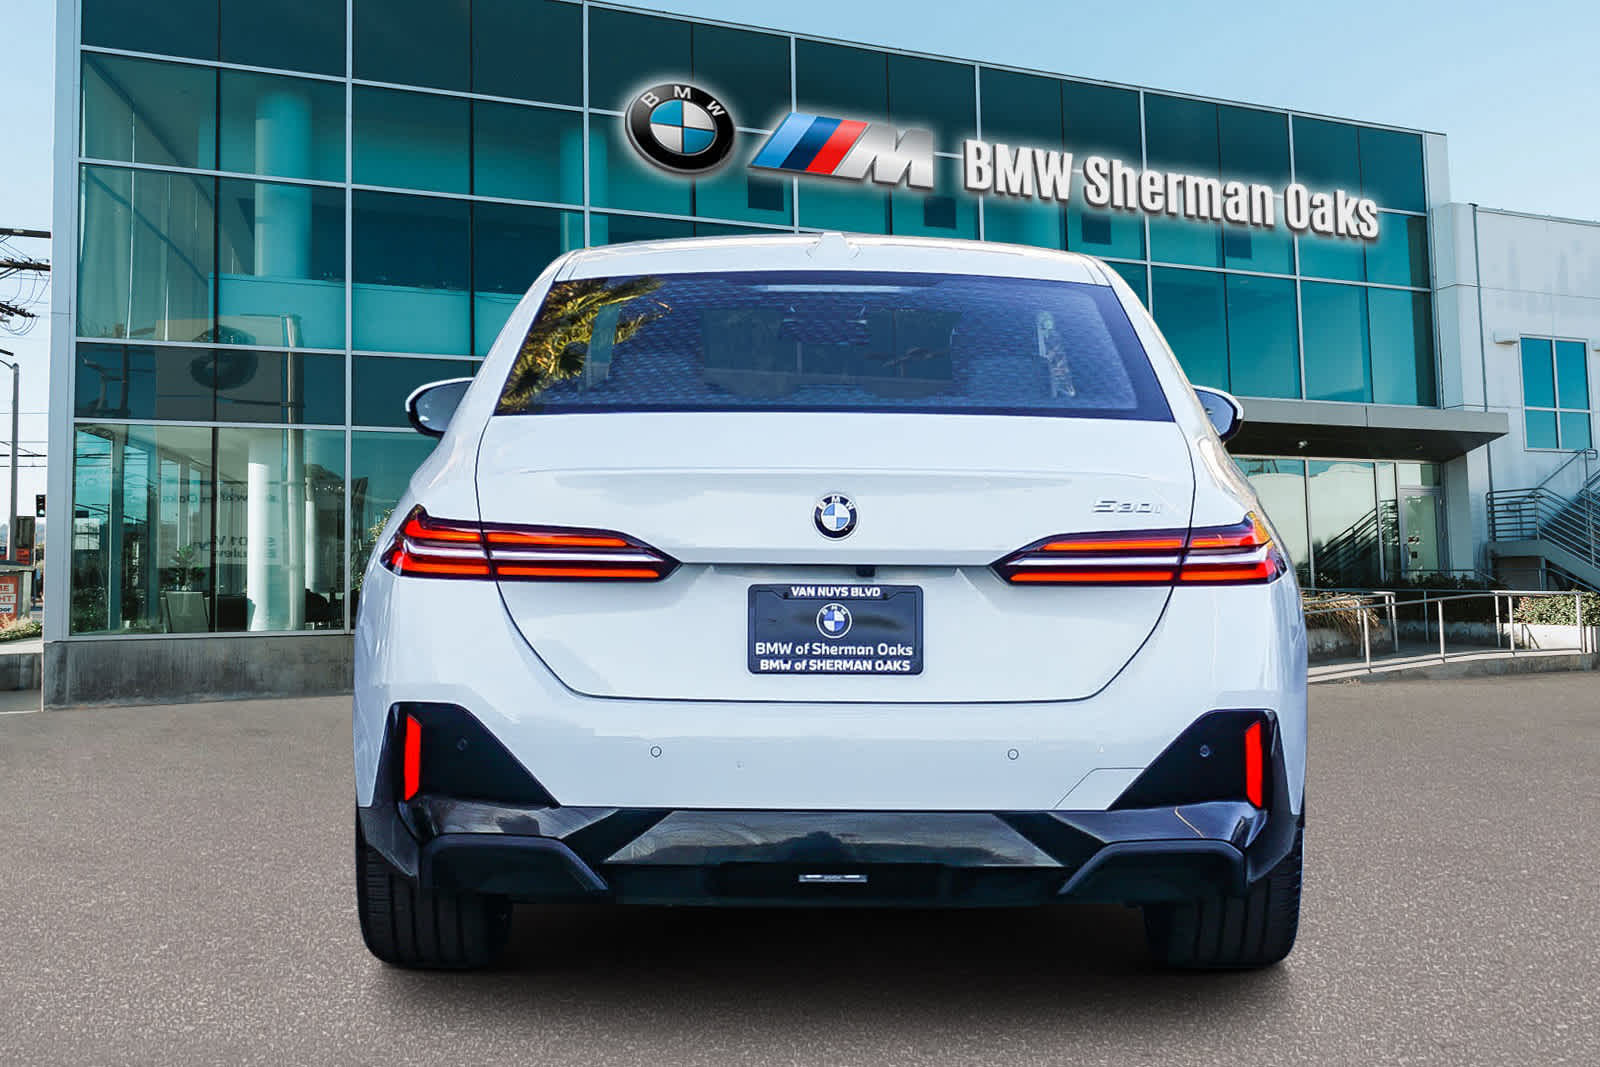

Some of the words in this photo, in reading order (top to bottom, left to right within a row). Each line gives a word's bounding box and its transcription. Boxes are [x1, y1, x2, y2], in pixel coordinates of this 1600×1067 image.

[641, 85, 725, 117] BMW
[963, 139, 1073, 201] BMW
[1083, 155, 1276, 228] Sherman
[1284, 183, 1379, 240] Oaks
[791, 586, 816, 597] VAN
[817, 586, 849, 597] NUYS
[851, 587, 881, 597] BLVD
[755, 642, 793, 655] BMW
[795, 642, 810, 655] of
[812, 643, 874, 655] Sherman
[877, 643, 913, 656] Oaks
[760, 659, 793, 671] BMW
[794, 659, 807, 671] of
[809, 659, 872, 671] SHERMAN
[875, 660, 910, 671] OAKS
